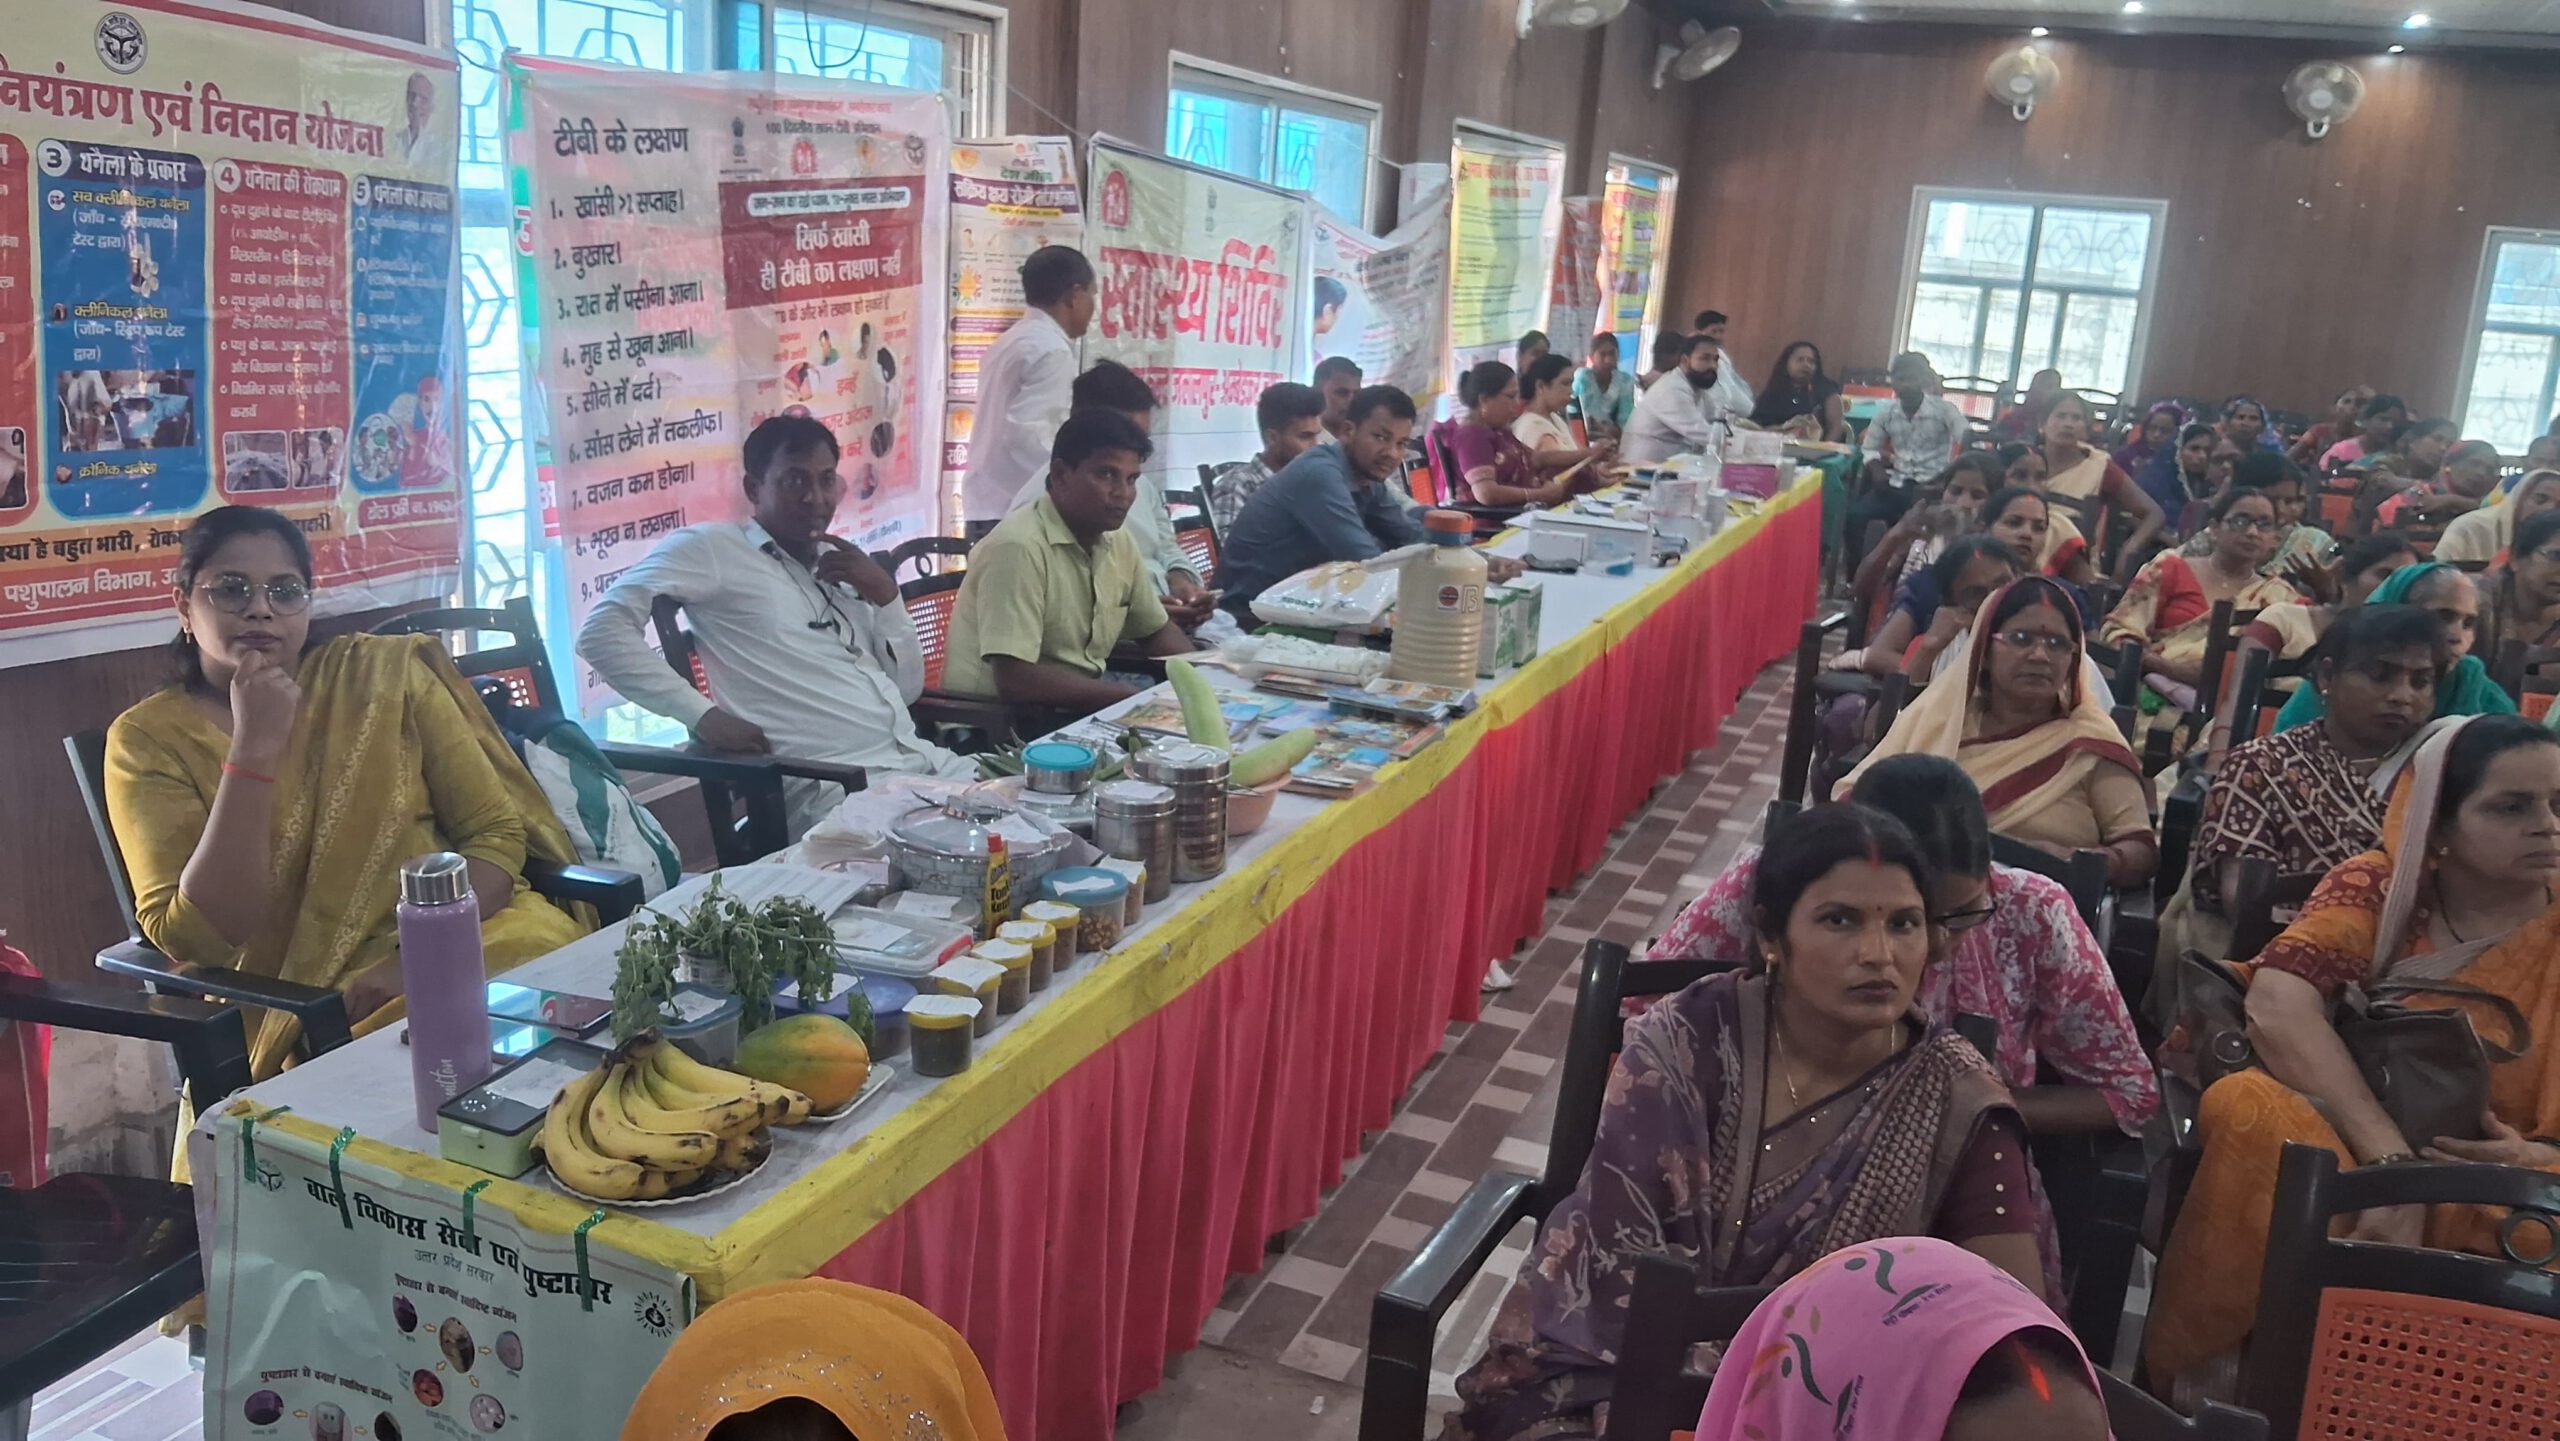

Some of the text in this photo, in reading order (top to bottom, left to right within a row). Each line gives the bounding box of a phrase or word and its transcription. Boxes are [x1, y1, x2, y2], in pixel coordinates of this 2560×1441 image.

[141, 80, 193, 137] एवं
[200, 82, 299, 145] निदान
[304, 100, 385, 157] योजना
[553, 117, 689, 157] टीबी के लक्षण
[46, 147, 62, 168] 3
[129, 151, 145, 178] के
[147, 158, 187, 182] प्रकार
[220, 166, 234, 185] 4
[356, 182, 366, 199] 5
[574, 184, 615, 219] खांसी
[795, 218, 871, 251] सिर्फ खांसी
[554, 248, 567, 270] 2.
[760, 260, 776, 291] ही
[779, 257, 811, 288] टीबी
[814, 260, 835, 284] का
[838, 256, 879, 282] लक्षण
[557, 298, 571, 320] 3.
[574, 293, 601, 317] रात
[605, 283, 622, 313] में
[624, 280, 665, 311] पसीना
[1100, 246, 1213, 342] स्वास्थ्य
[1214, 237, 1289, 349] शिविर
[607, 331, 622, 361] से
[625, 335, 654, 368] खून
[582, 381, 611, 412] सीने
[614, 377, 630, 405] में
[584, 428, 614, 459] सांस
[617, 422, 644, 452] लेने
[648, 417, 662, 444] में
[586, 477, 623, 505] वजन
[628, 471, 654, 494] कम
[31, 537, 48, 559] है
[52, 538, 93, 562] बहुत
[590, 524, 619, 560] भूख
[622, 521, 636, 541] न
[4, 577, 89, 610] पशुपालन
[353, 1191, 428, 1241] विकास
[489, 1241, 521, 1275] एवं
[466, 1263, 495, 1284] सरकार
